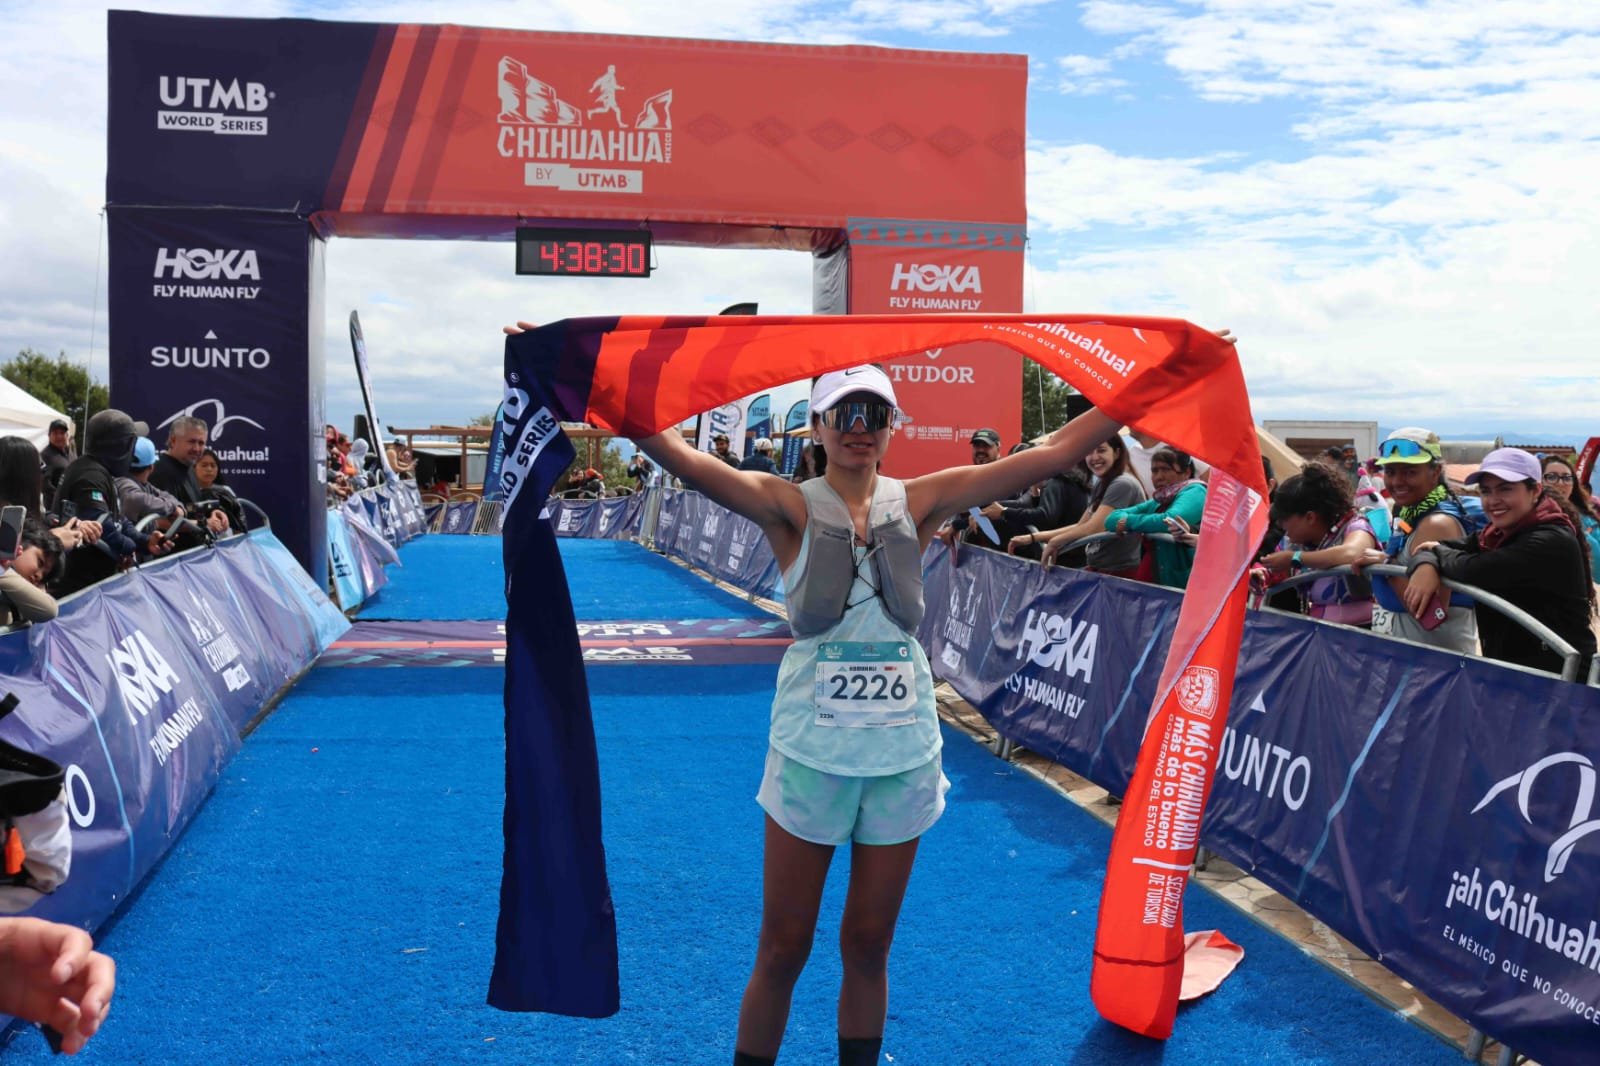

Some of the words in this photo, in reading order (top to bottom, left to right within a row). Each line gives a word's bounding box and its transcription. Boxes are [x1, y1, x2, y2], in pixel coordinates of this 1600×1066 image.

[159, 76, 269, 112] UTMB
[163, 114, 215, 127] WORLD
[220, 119, 264, 132] SERIES
[497, 126, 664, 163] CHIHUAHUA
[535, 168, 553, 180] BY
[578, 173, 628, 188] UTMB
[153, 247, 262, 281] HOKA
[540, 241, 646, 274] 4:38:30
[153, 284, 177, 297] FLY
[179, 285, 235, 299] HUMAN
[236, 286, 261, 299] FLY
[890, 262, 983, 294] HOKA
[889, 296, 909, 308] FLY
[911, 298, 960, 310] HUMAN
[961, 299, 982, 311] FLY
[150, 346, 271, 369] SUUNTO
[889, 363, 976, 384] TUDOR
[1037, 337, 1057, 350] QUE
[1058, 347, 1072, 359] NO
[1073, 357, 1113, 391] CONOCES
[209, 445, 270, 461] uahua!
[516, 414, 557, 469] SERIES
[502, 470, 518, 505] RLD
[1016, 608, 1100, 684] HOKA
[829, 674, 908, 701] 2226
[1023, 676, 1066, 713] HUMAN
[1063, 692, 1086, 719] FLY
[1154, 713, 1175, 778] GOBIERNO
[1169, 716, 1187, 753] más
[1183, 719, 1215, 762] MÁS
[1165, 756, 1181, 778] de
[1215, 725, 1312, 812] UNTO
[1149, 779, 1162, 802] DEL
[1163, 781, 1179, 797] lo
[1169, 761, 1207, 851] CHIHUAHUA
[1143, 805, 1159, 847] ESTADO
[1155, 800, 1176, 849] bueno
[1148, 872, 1166, 887] DE
[1142, 886, 1164, 925] TURISMO
[1485, 879, 1600, 975] Chihuah
[1442, 924, 1455, 942] EL
[1457, 935, 1496, 965] MÉXICO
[1502, 959, 1529, 983] QUE
[1532, 975, 1551, 995] NO
